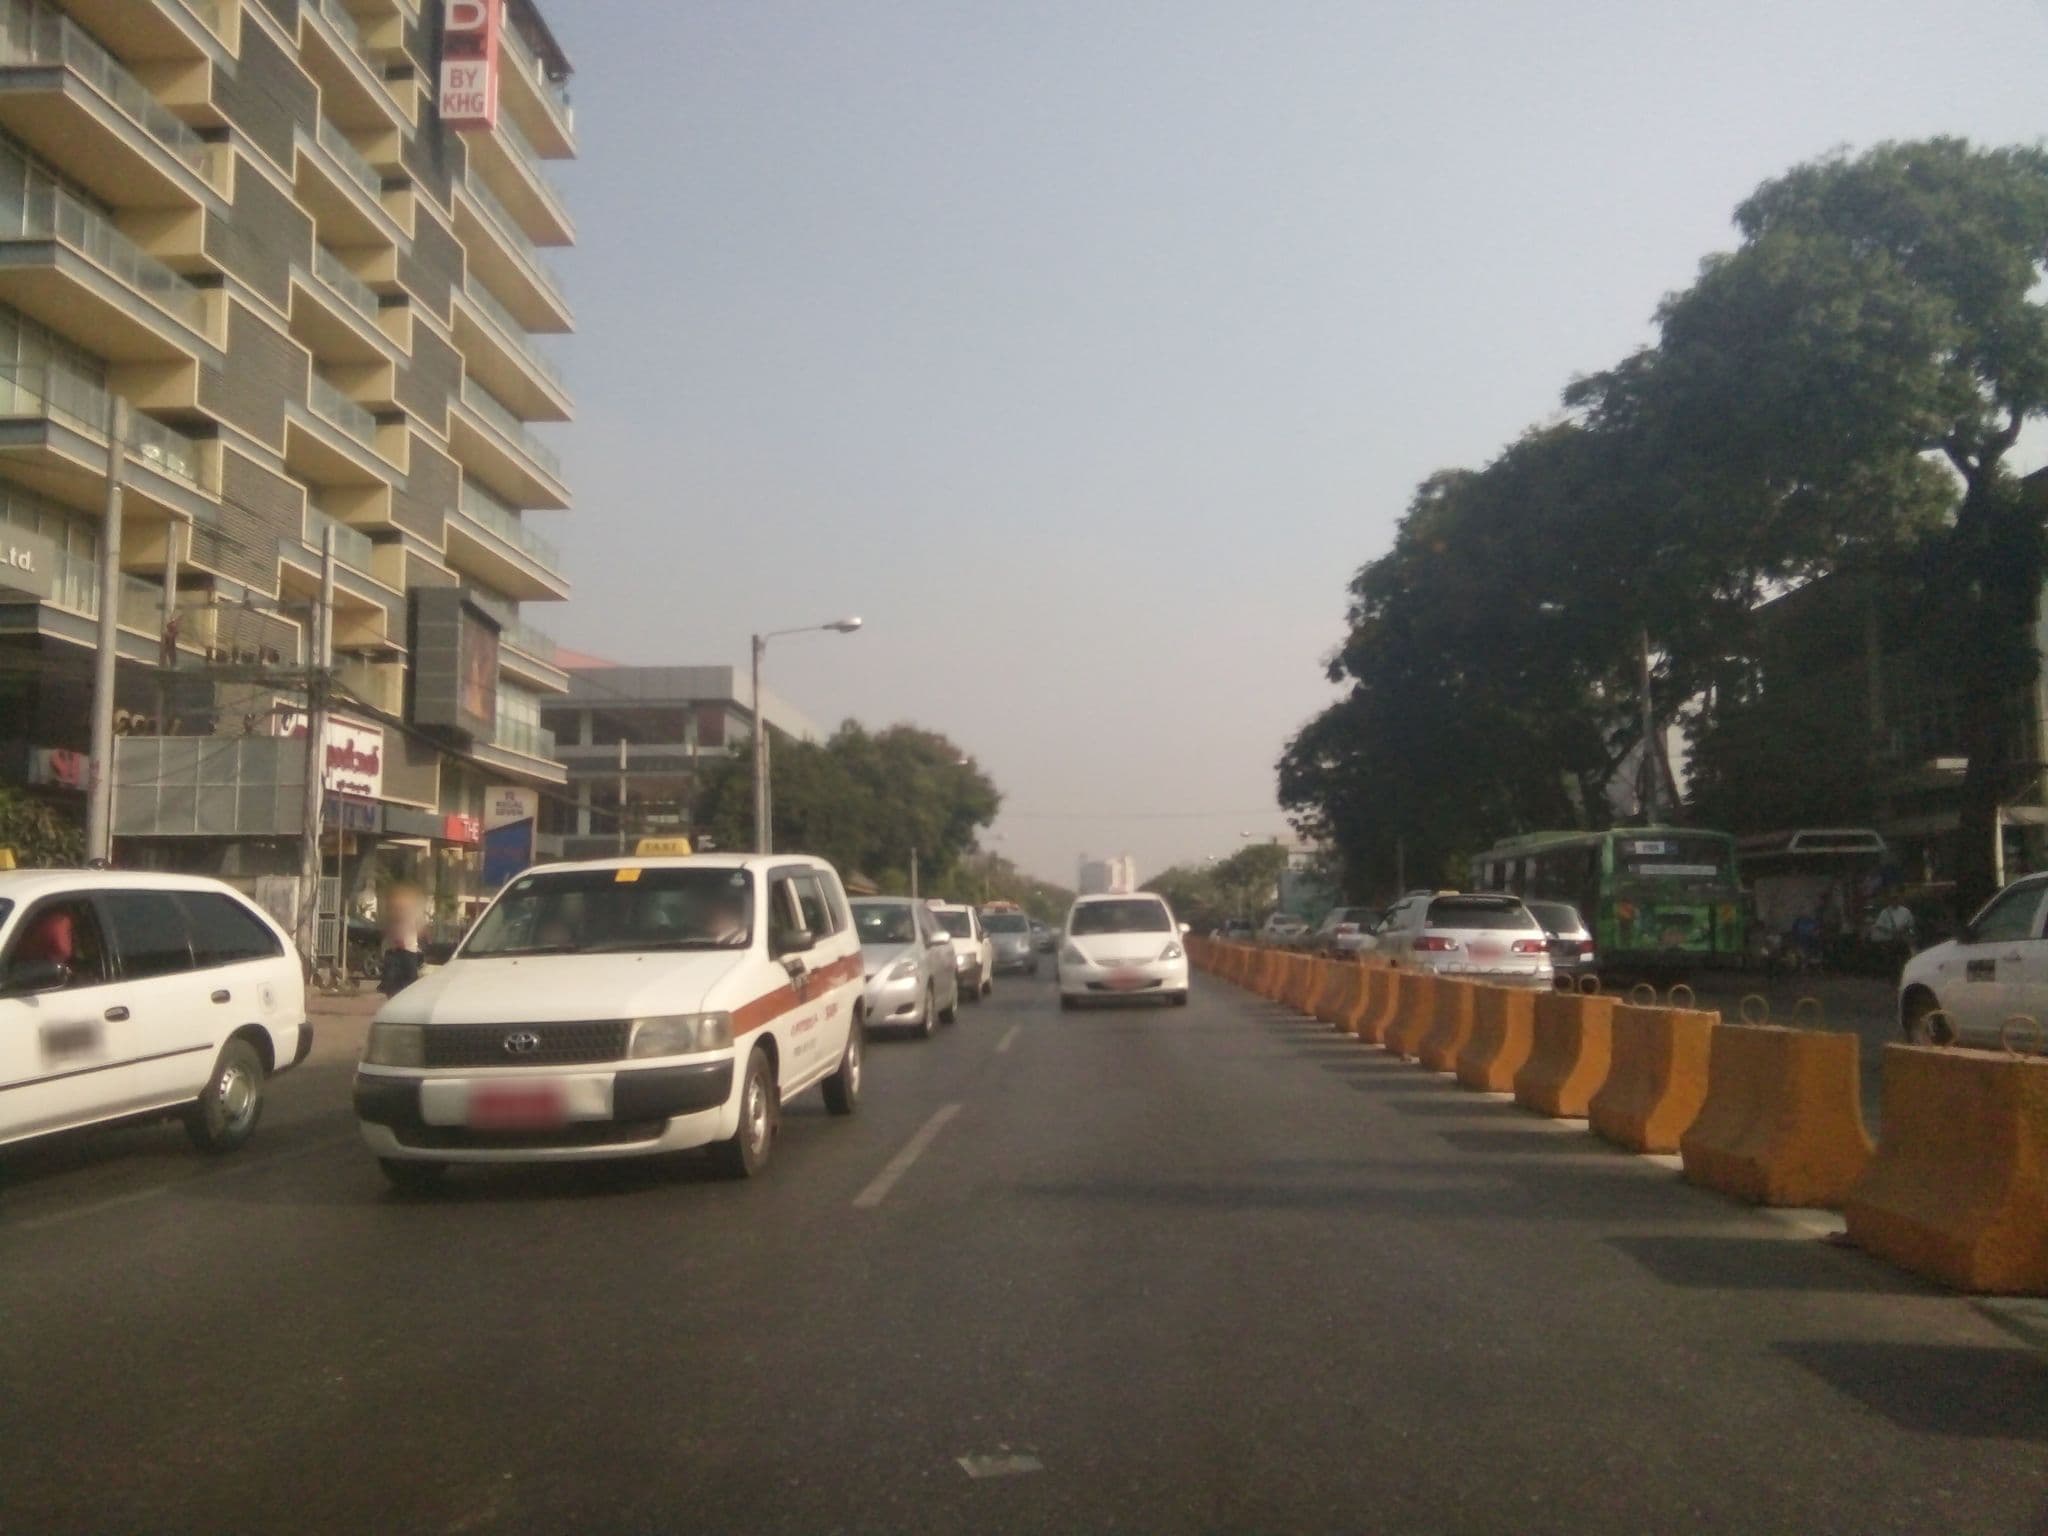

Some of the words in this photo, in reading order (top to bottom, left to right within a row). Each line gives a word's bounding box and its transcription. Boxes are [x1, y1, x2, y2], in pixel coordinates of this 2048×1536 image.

[450, 68, 478, 89] BY
[443, 92, 485, 113] KHG
[463, 820, 480, 841] THE
